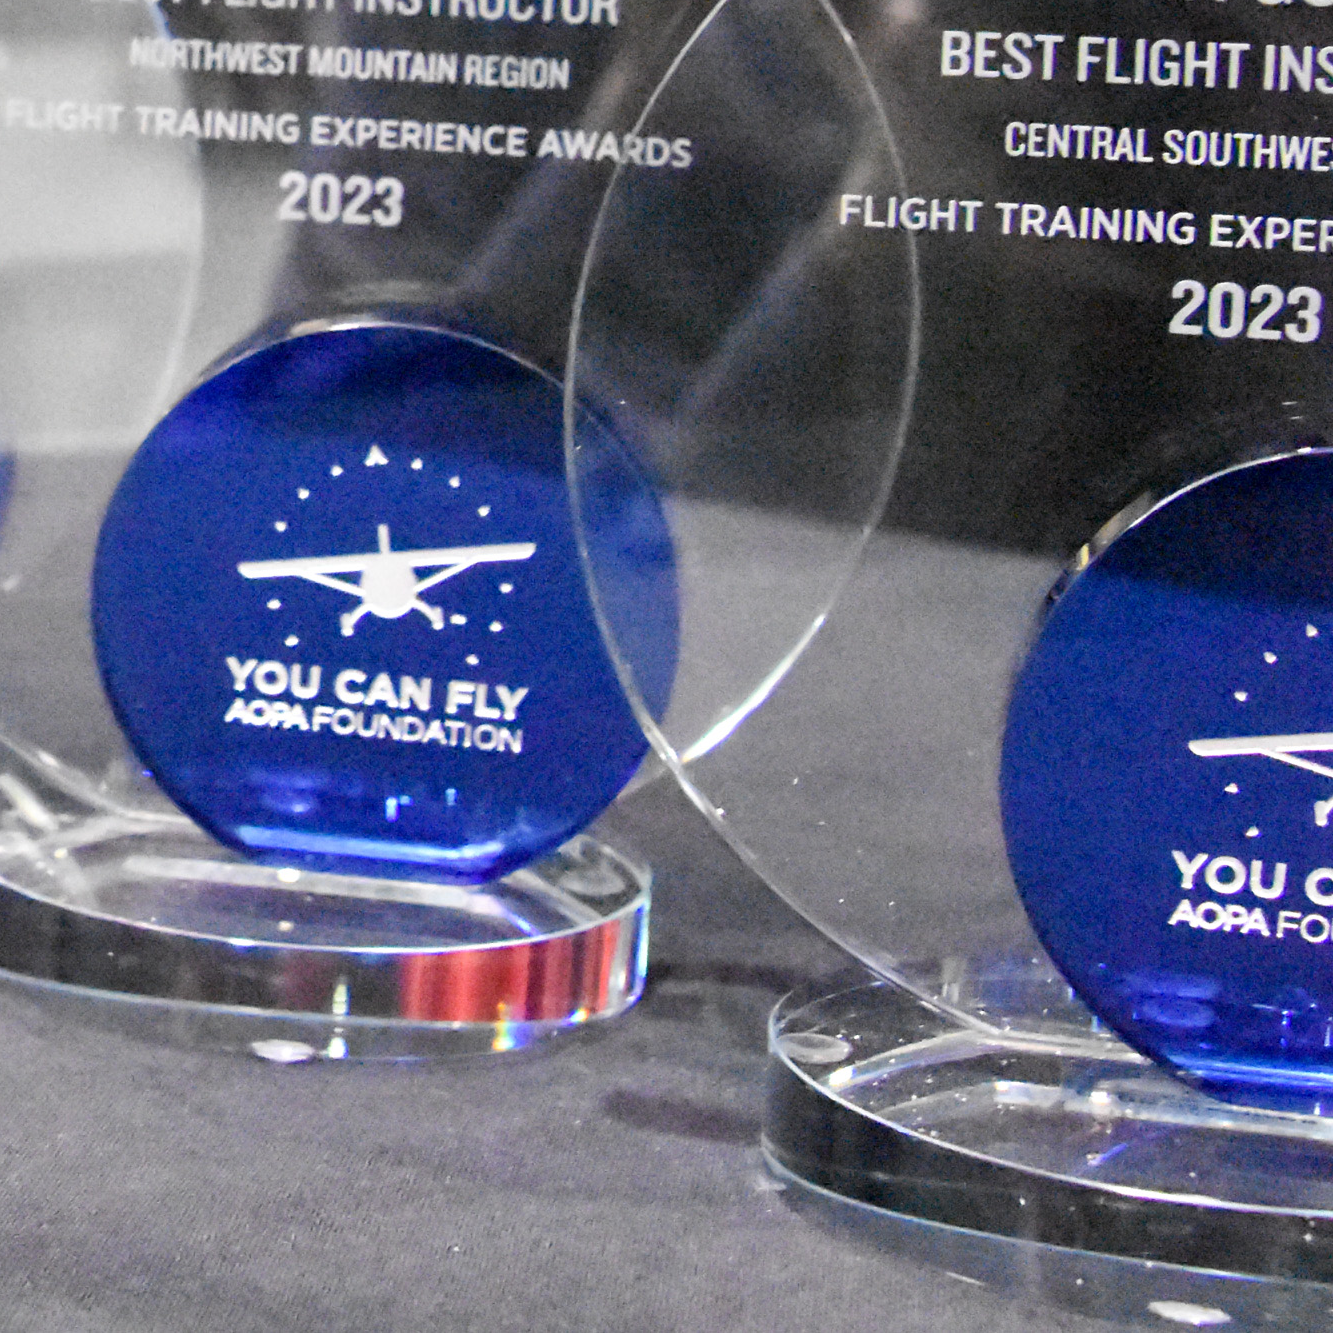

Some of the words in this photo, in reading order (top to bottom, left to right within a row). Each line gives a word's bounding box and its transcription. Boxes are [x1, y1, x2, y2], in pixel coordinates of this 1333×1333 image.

[129, 37, 302, 76] NORTHWEST
[309, 46, 459, 85] MOUNTAIN
[464, 53, 569, 91] REGION
[941, 30, 1064, 81] BEST
[1077, 36, 1250, 89] FLIGHT
[5, 98, 122, 134] FLIGHT
[136, 105, 300, 145] TRAINING
[310, 114, 527, 158] EXPERIENCE
[538, 129, 693, 168] AWARDS
[1005, 122, 1153, 163] CENTRAL
[1162, 129, 1333, 172] SOUTHWE
[277, 172, 403, 228] 2023
[840, 194, 983, 233] FLIGHT
[996, 201, 1196, 245] TRAINING
[1168, 279, 1323, 343] 2023
[226, 656, 321, 698] YOU
[335, 668, 431, 711] CAN
[445, 679, 529, 720] FLY
[225, 697, 309, 731] AOPA
[312, 707, 523, 753] FOUNDATION
[1171, 850, 1287, 900] YOU
[1167, 899, 1271, 937] AOPA
[1276, 910, 1333, 944] FO
